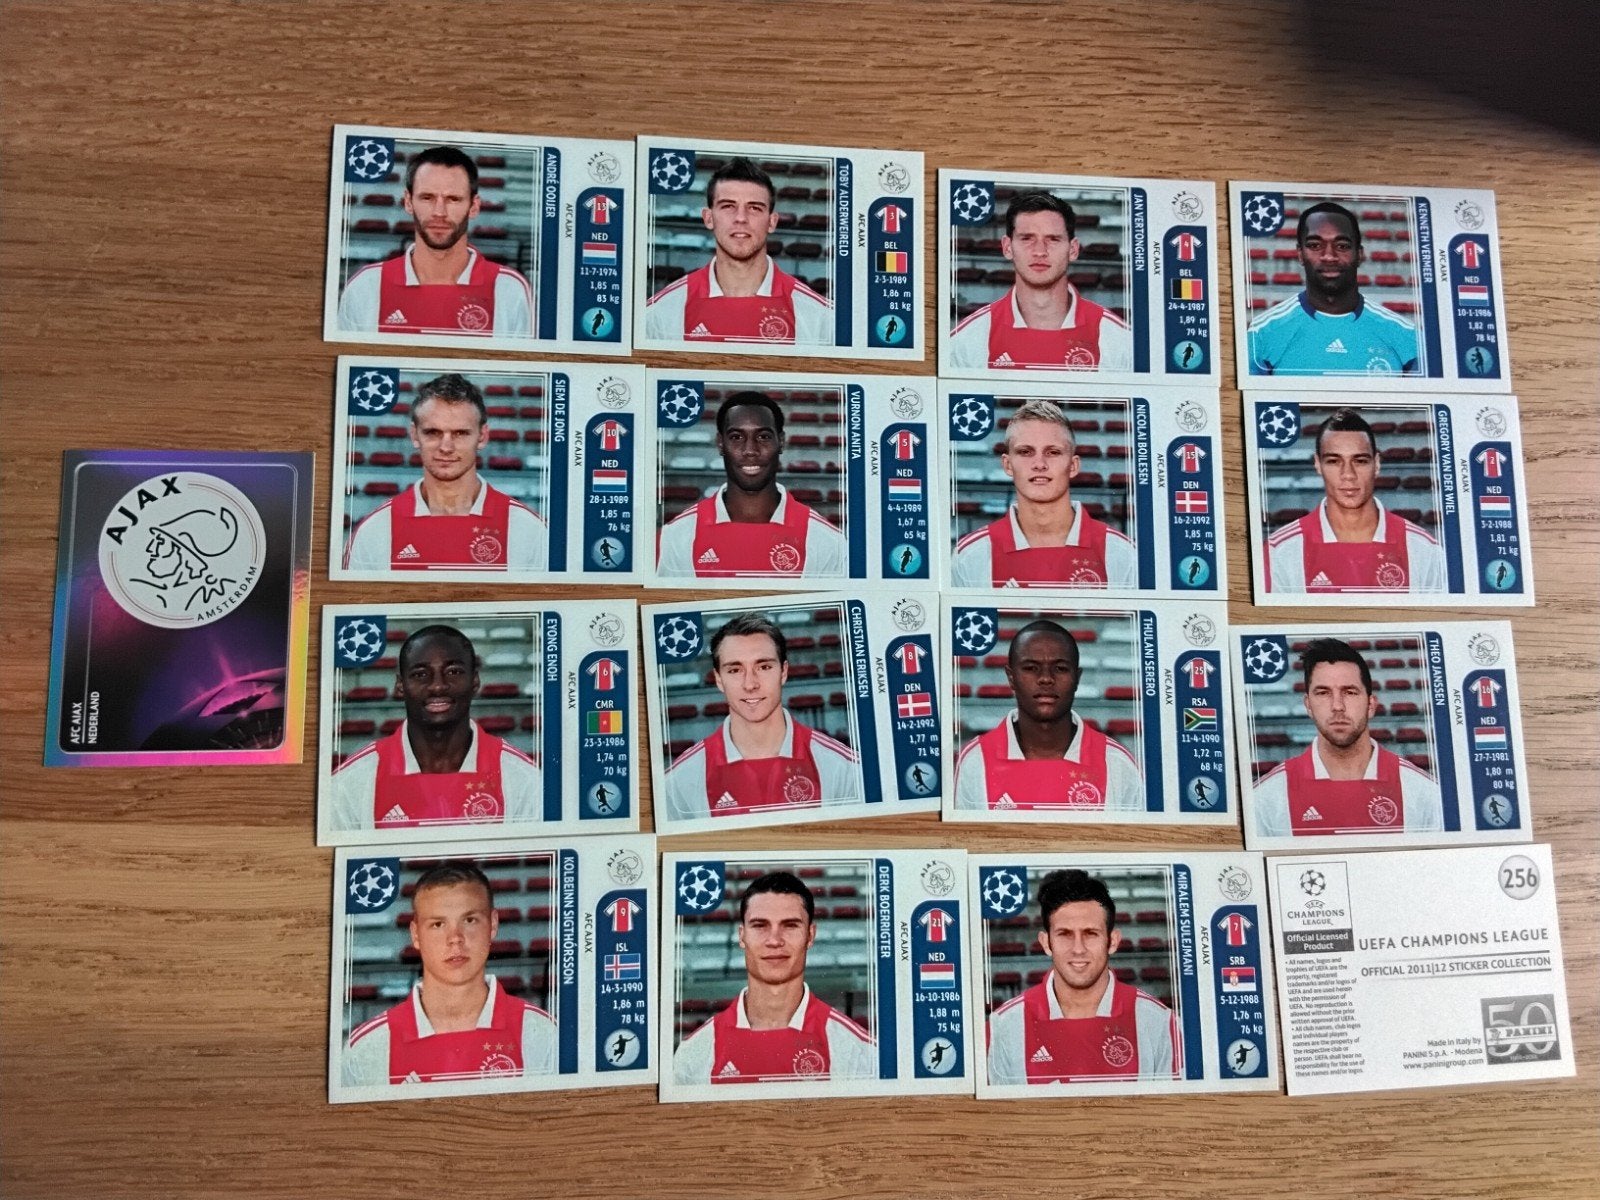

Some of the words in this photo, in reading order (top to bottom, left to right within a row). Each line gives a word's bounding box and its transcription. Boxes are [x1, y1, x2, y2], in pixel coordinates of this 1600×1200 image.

[547, 154, 559, 184] ANDRÉ
[840, 165, 849, 187] TOBY
[546, 186, 556, 217] OOIJER
[1134, 194, 1143, 210] JAN
[839, 189, 848, 256] ALDERWEIRELD
[1419, 203, 1429, 242] KENNETH
[884, 241, 897, 249] BEL
[1135, 212, 1144, 270] VERTONGHEN
[1422, 244, 1432, 282] VERMEER
[581, 267, 617, 276] 11-7-1974
[1180, 269, 1192, 277] BEL
[875, 275, 907, 284] 2-3-1989
[597, 294, 606, 302] 83
[610, 294, 619, 304] kg
[902, 302, 911, 311] kg
[1169, 302, 1205, 310] 24-4-1987
[1458, 309, 1492, 317] 10-1-1986
[1198, 328, 1207, 337] kg
[555, 380, 565, 400] SIEM
[555, 403, 565, 415] DE
[851, 391, 860, 429] VURNON
[1137, 405, 1146, 440] NICOLAI
[555, 418, 565, 441] JONG
[1438, 411, 1450, 451] GREGORY
[852, 432, 861, 459] ANITA
[602, 460, 618, 468] NED
[1138, 442, 1148, 484] BOILESEN
[1442, 454, 1451, 471] VAN
[897, 469, 913, 477] NED
[1183, 481, 1199, 489] DEN
[1444, 474, 1453, 491] DER
[1462, 474, 1470, 492] AJAX
[590, 495, 628, 503] 28-1-1989
[1445, 493, 1455, 514] WIEL
[106, 476, 182, 545] AJAX
[888, 504, 922, 512] 4-4-1989
[1174, 516, 1210, 524] 16-2-1992
[1481, 520, 1512, 528] 3-2-1988
[608, 523, 617, 531] 76
[621, 523, 630, 533] kg
[904, 531, 913, 539] 65
[917, 531, 926, 540] kg
[1204, 542, 1213, 552] kg
[1509, 546, 1518, 556] kg
[197, 565, 257, 622] AMSTERDAM
[547, 619, 557, 651] EYONG
[852, 607, 865, 656] CHRISTIAN
[1144, 618, 1154, 658] THULANI
[1430, 639, 1441, 663] THEO
[547, 654, 557, 681] ENOH
[876, 658, 884, 671] AFC
[568, 672, 576, 686] AFC
[856, 659, 869, 697] ERIKSEN
[877, 674, 885, 693] AJAX
[1145, 661, 1155, 696] SERERO
[905, 683, 921, 692] DEN
[1432, 666, 1445, 705] JANSSEN
[1192, 698, 1207, 706] RSA
[1453, 689, 1461, 703] AFC
[595, 700, 613, 709] CMR
[71, 702, 82, 725] AJAX
[87, 691, 100, 744] NEDERLAND
[1455, 706, 1463, 725] AJAX
[897, 719, 934, 730] 14-2-1992
[1481, 717, 1496, 725] NED
[70, 726, 81, 744] AFC
[1182, 734, 1220, 743] 11-4-1990
[584, 737, 625, 747] 23-3-1986
[918, 748, 927, 756] 71
[930, 747, 939, 756] kg
[1474, 753, 1509, 761] 27-7-1981
[604, 767, 614, 775] 70
[617, 766, 626, 776] kg
[1201, 763, 1210, 771] 68
[1213, 762, 1222, 772] kg
[1493, 780, 1503, 789] 80
[1505, 780, 1514, 789] kg
[564, 857, 574, 907] KOLBEINN
[879, 866, 889, 892] DERK
[1503, 867, 1537, 889] 256
[1178, 872, 1189, 917] MIRALEM
[1287, 910, 1345, 919] CHAMPIONS
[880, 895, 890, 957] BOERRIGTER
[1287, 934, 1314, 942] Official
[1316, 932, 1349, 940] Licensed
[1358, 936, 1396, 951] UEFA
[1401, 931, 1488, 949] CHAMPIONS
[1493, 928, 1549, 942] LEAGUE
[563, 910, 576, 984] SIGTHÓRSSON
[616, 943, 628, 951] ISL
[1180, 920, 1193, 975] SULEJMANI
[1303, 942, 1334, 950] Product
[929, 953, 945, 961] NED
[1202, 944, 1210, 964] AJAX
[1230, 956, 1245, 965] SRB
[1361, 965, 1405, 977] OFFICIAL
[1449, 960, 1489, 972] STICKER
[1491, 956, 1551, 969] COLLECTION
[602, 982, 643, 994] 14-3-1990
[916, 992, 960, 1001] 16-10-1986
[1221, 995, 1259, 1004] 5-12-1988
[622, 1014, 631, 1023] 78
[635, 1013, 644, 1024] kg
[938, 1023, 947, 1032] 75
[951, 1022, 960, 1033] kg
[1241, 1025, 1250, 1034] 76
[1253, 1024, 1263, 1035] kg
[1487, 1001, 1556, 1057] 50
[1506, 1025, 1553, 1037] PANINI
[1427, 1039, 1446, 1047] Made
[1456, 1038, 1471, 1046] Italy
[1472, 1037, 1481, 1045] by
[1403, 1051, 1427, 1059] PANINI
[1454, 1048, 1482, 1056] Modena
[1403, 1057, 1484, 1070] www.paninigroup.com
